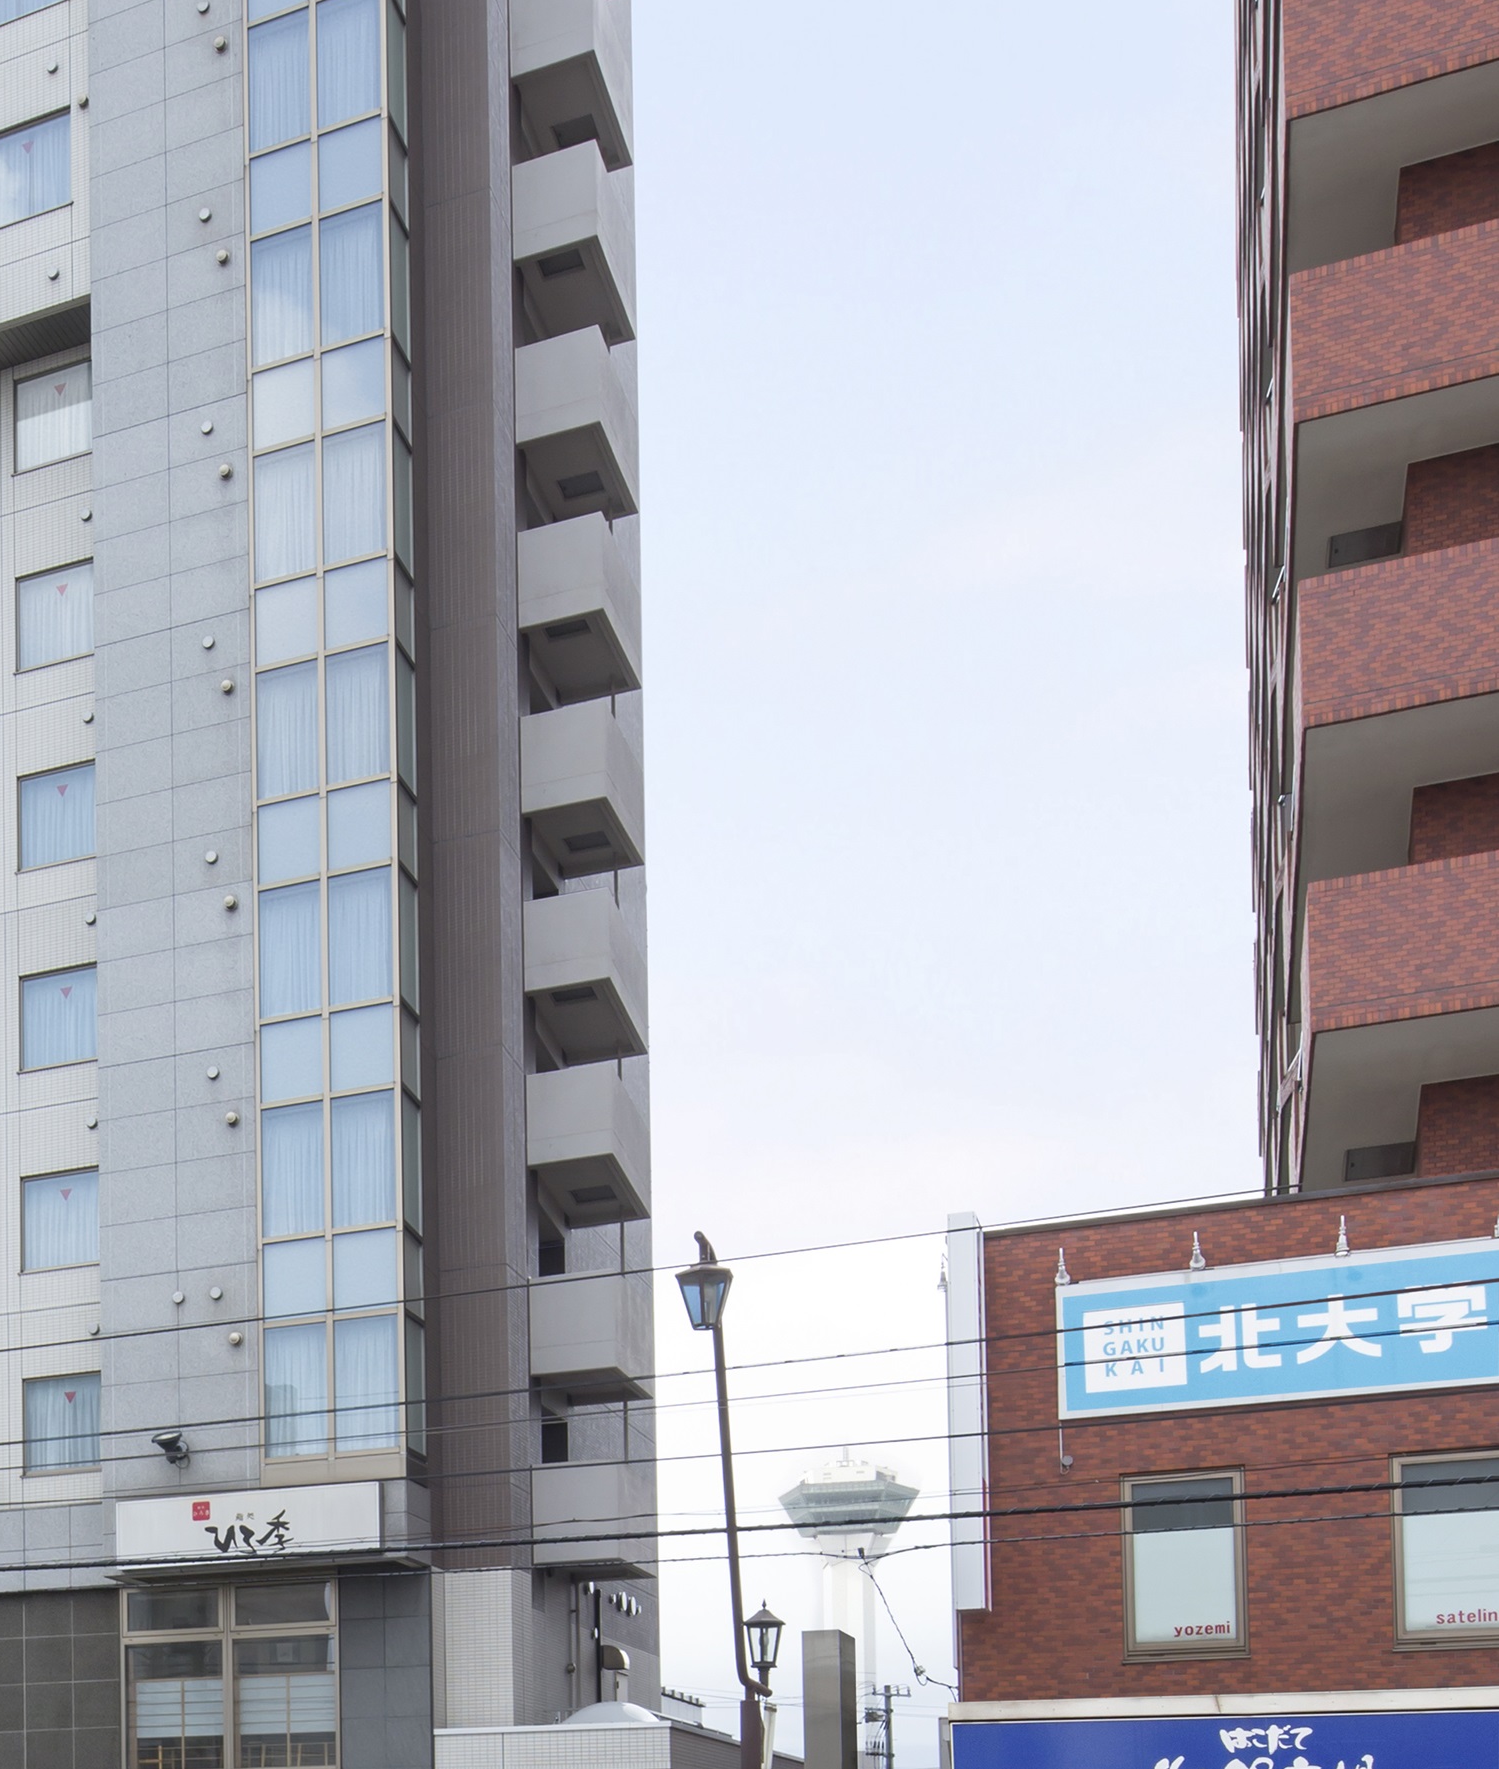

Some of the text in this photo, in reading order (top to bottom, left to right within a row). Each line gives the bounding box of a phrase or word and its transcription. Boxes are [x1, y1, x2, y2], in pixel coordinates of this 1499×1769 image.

[1103, 1316, 1164, 1335] SHIN
[1198, 1281, 1488, 1374] 北大学
[1103, 1337, 1164, 1356] GAKU
[1105, 1358, 1164, 1377] KAI
[1436, 1608, 1498, 1625] satelin
[1174, 1621, 1231, 1637] yozemi
[1219, 1724, 1313, 1755] はこだて
